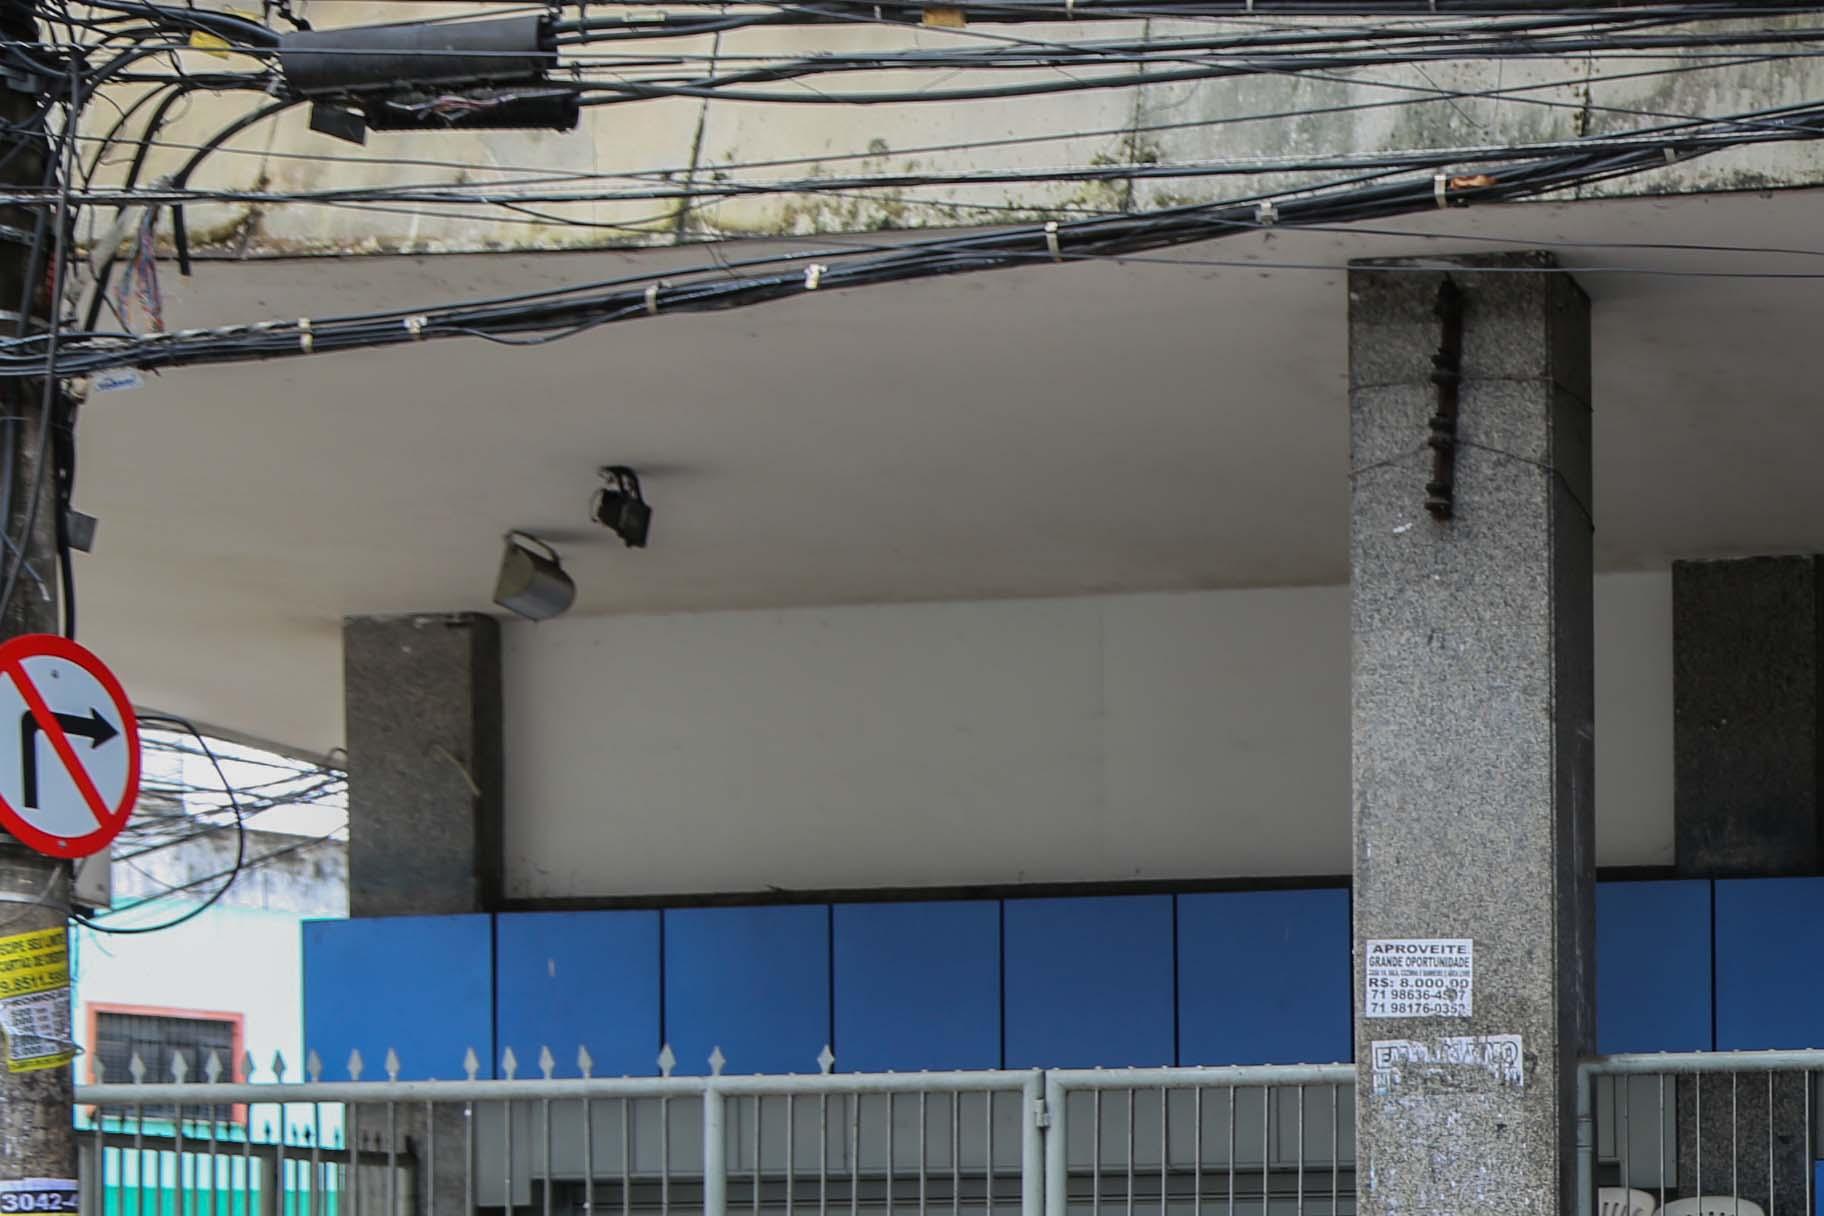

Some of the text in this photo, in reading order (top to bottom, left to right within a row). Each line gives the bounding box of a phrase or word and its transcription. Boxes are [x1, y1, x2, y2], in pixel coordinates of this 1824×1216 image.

[1373, 944, 1467, 954] APROVEITE
[1369, 956, 1470, 967] GRANDE OPORTUNIDADE
[1371, 990, 1386, 999] 71
[1371, 1003, 1386, 1013] 71
